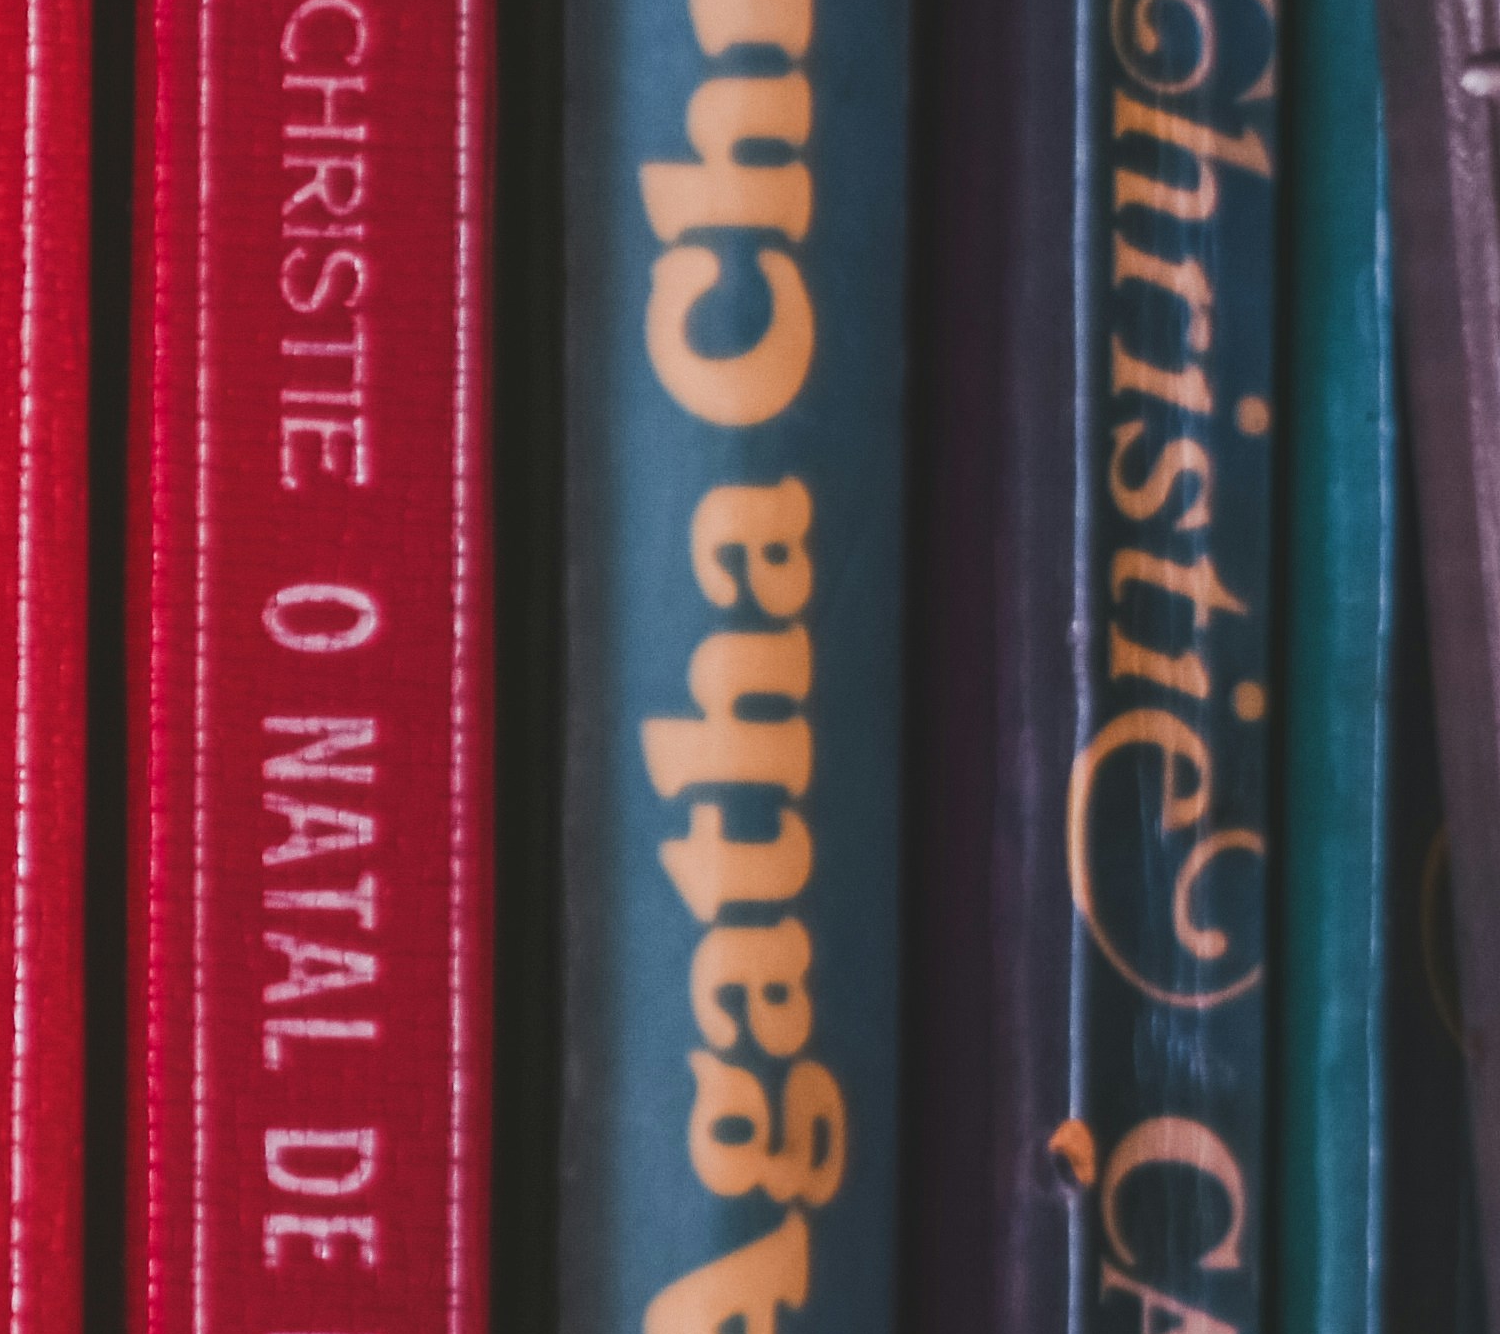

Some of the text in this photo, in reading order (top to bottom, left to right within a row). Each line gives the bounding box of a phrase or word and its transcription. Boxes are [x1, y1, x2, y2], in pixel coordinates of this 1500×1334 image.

[262, 582, 379, 651] O
[262, 716, 377, 1071] NATAL
[262, 1127, 376, 1269] DE
